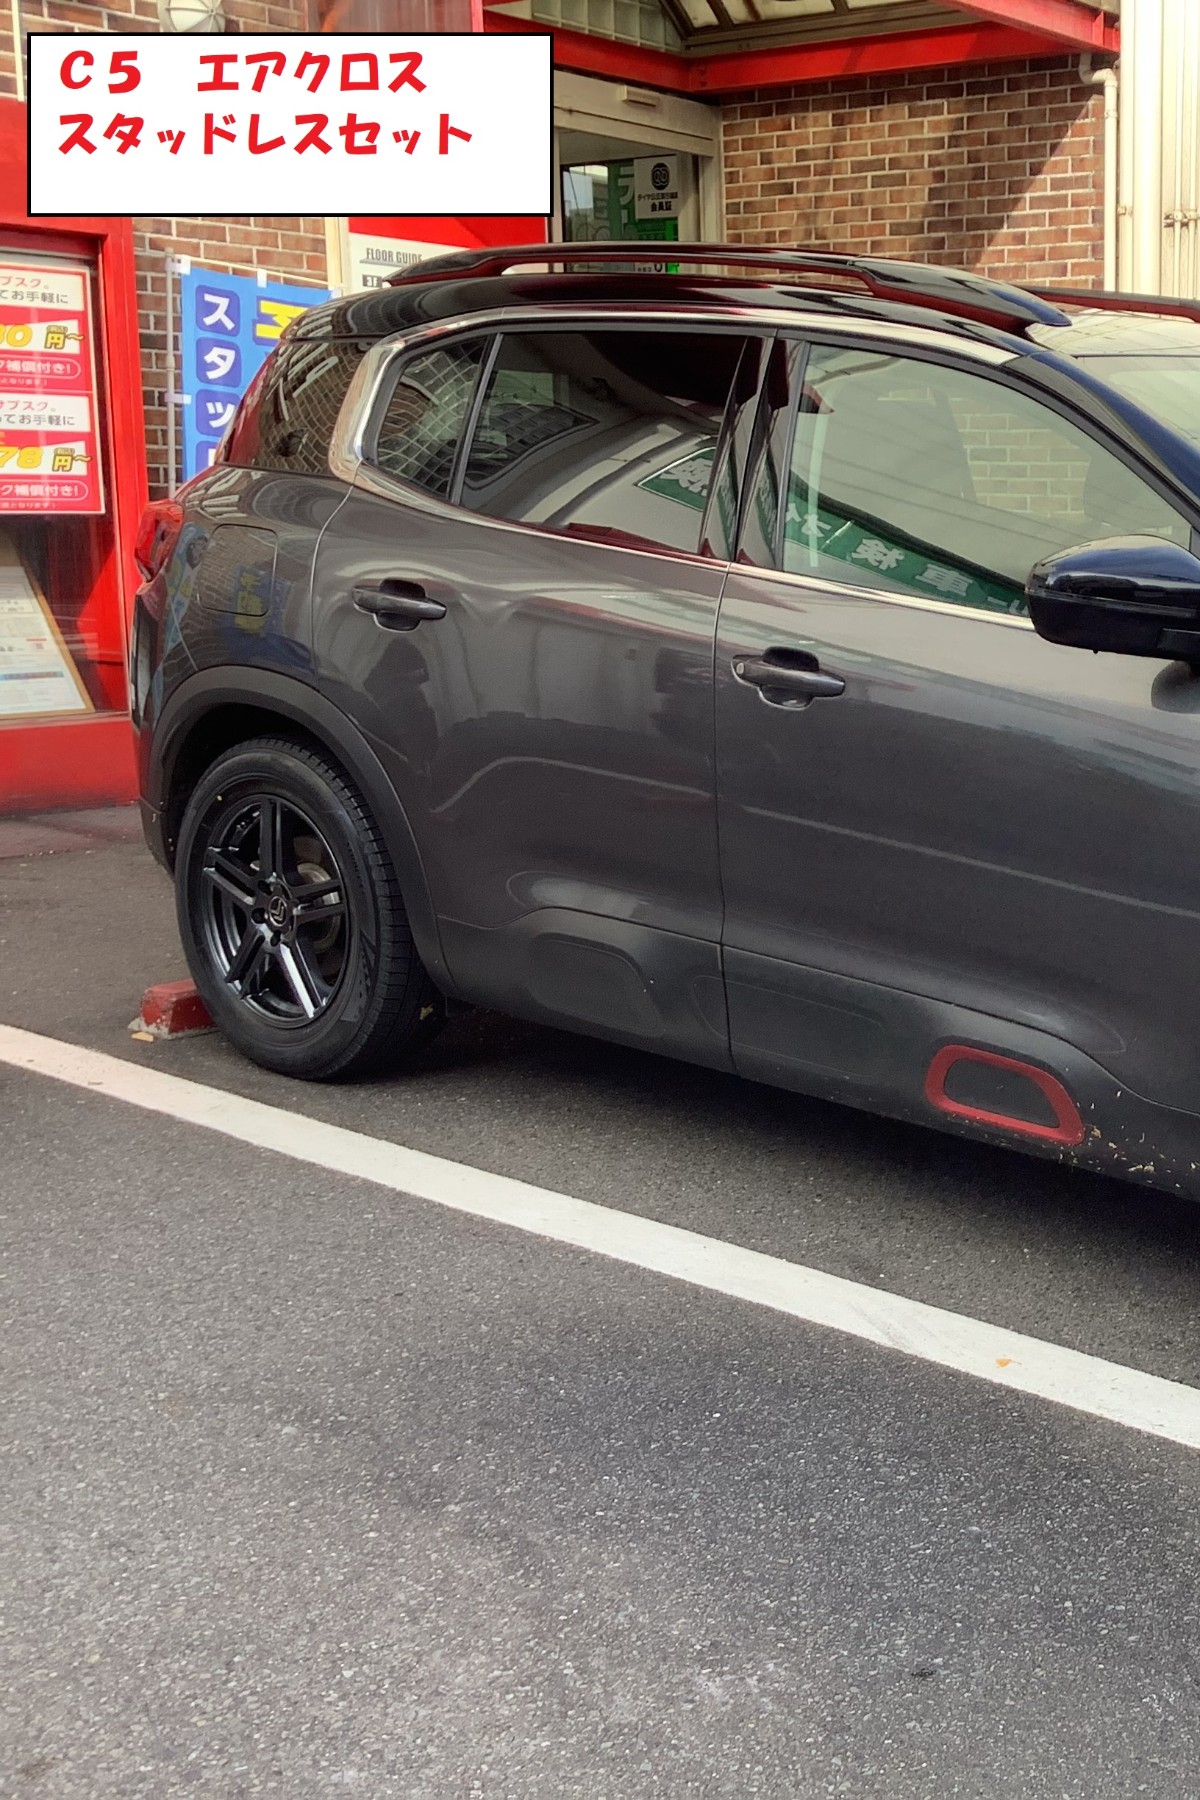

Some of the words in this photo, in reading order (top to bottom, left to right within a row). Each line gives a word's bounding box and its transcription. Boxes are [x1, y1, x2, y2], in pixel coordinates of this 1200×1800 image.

[366, 248, 394, 262] FLOOR
[0, 323, 33, 347] 0
[0, 413, 76, 426] てお手軽に
